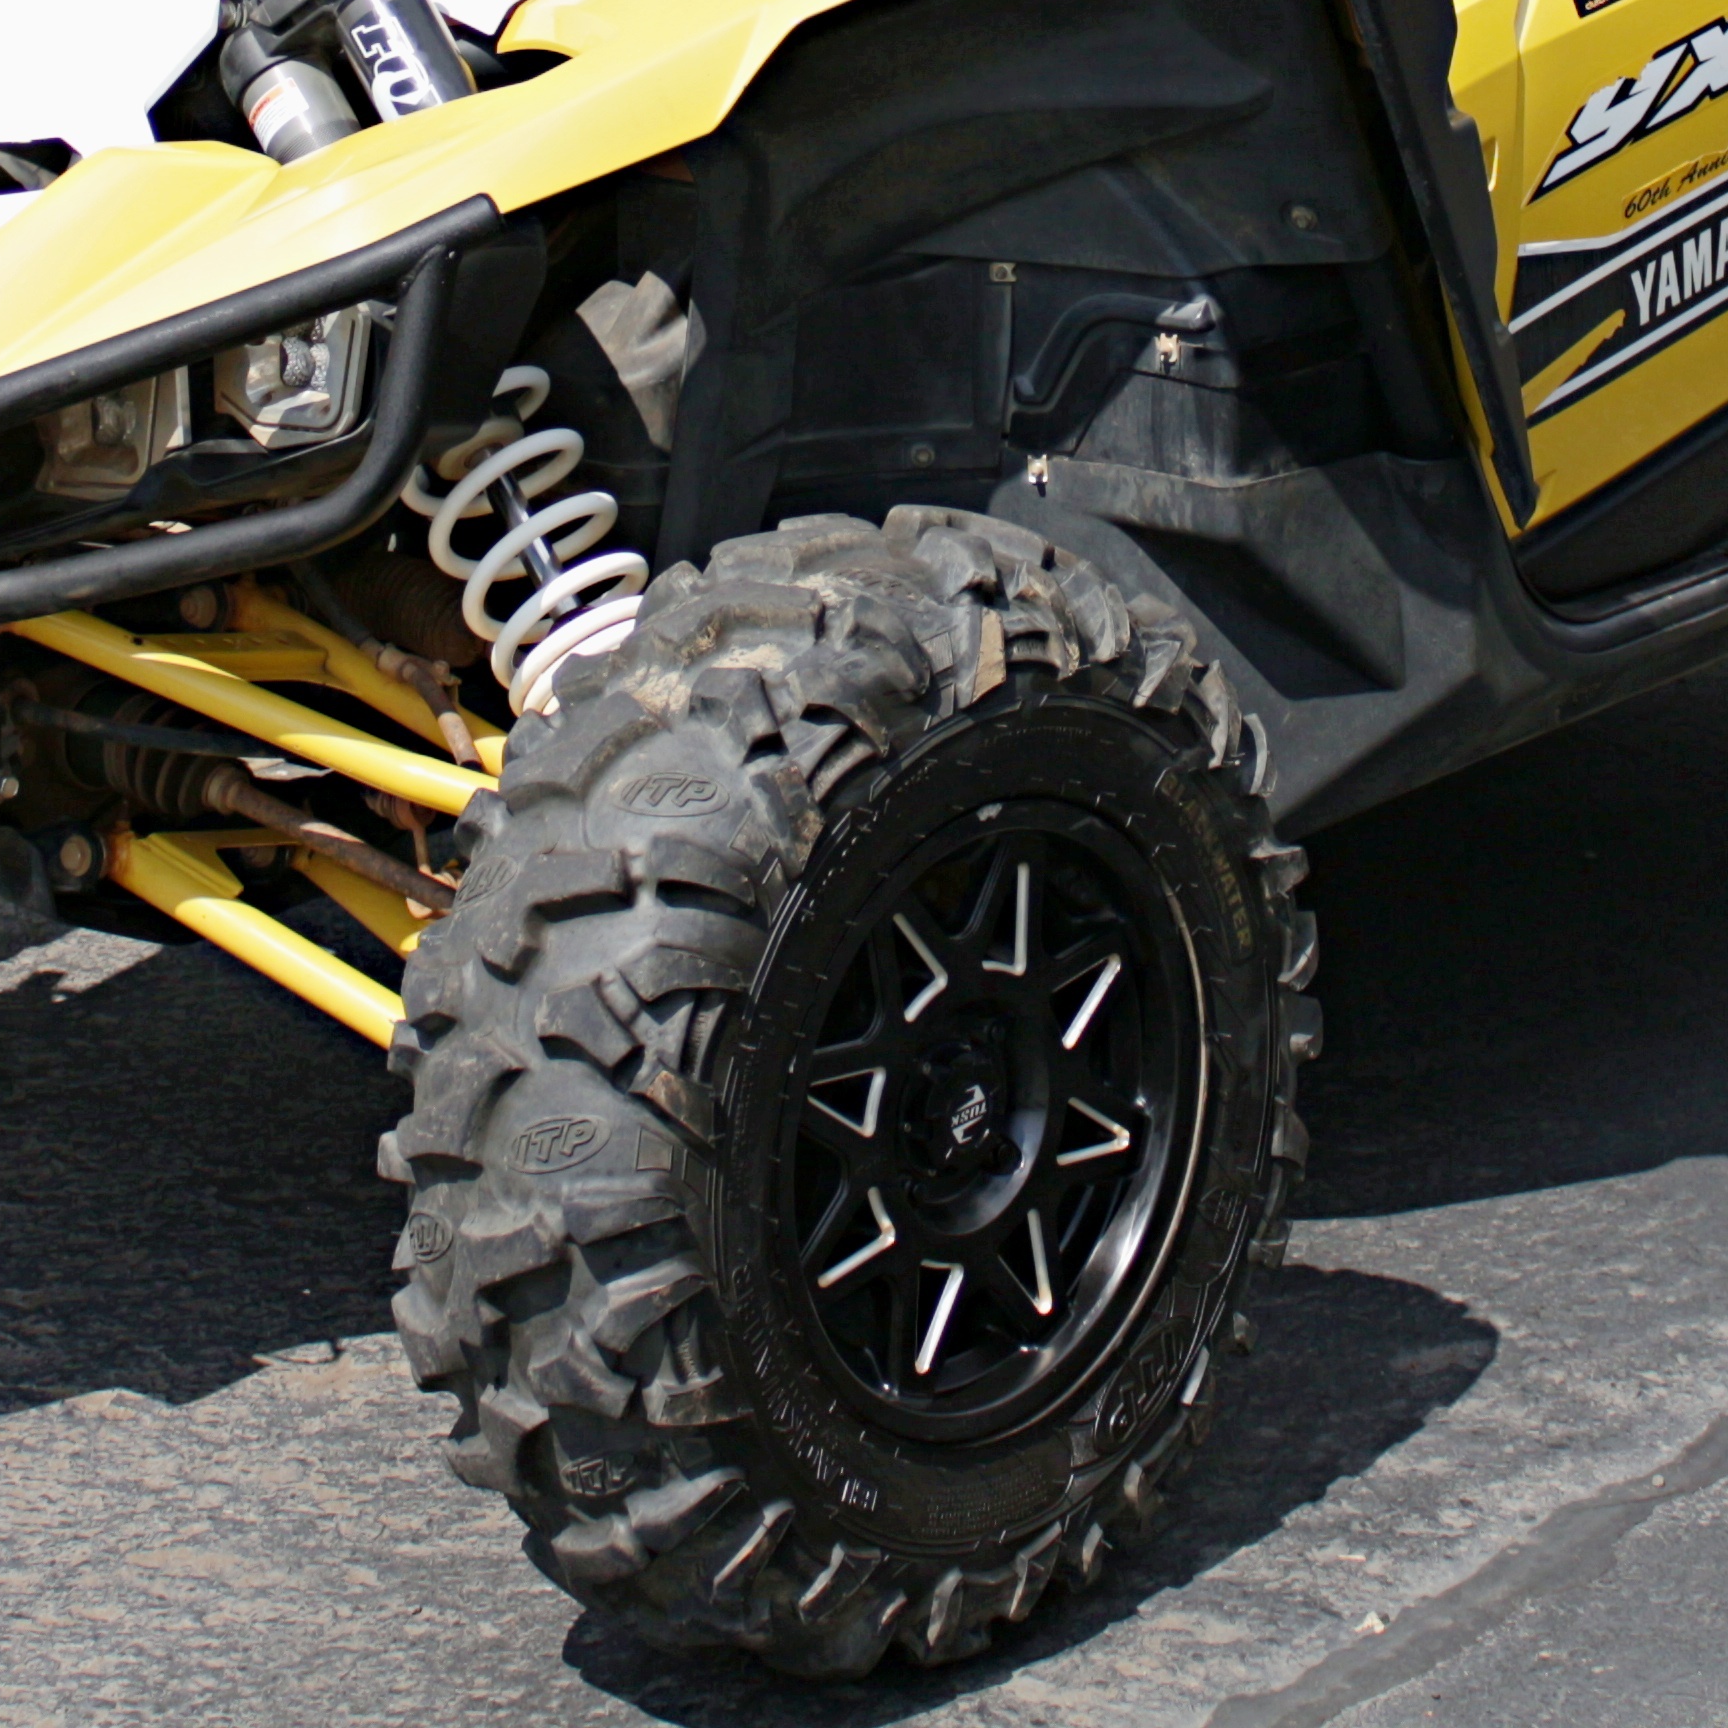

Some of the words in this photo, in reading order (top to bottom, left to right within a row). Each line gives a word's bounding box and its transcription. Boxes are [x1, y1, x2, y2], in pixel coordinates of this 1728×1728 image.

[1623, 176, 1672, 219] 60th
[623, 776, 719, 808] ITP
[951, 1100, 987, 1128] TUSK
[513, 1118, 597, 1166] ITP
[1108, 1329, 1184, 1443] ITP
